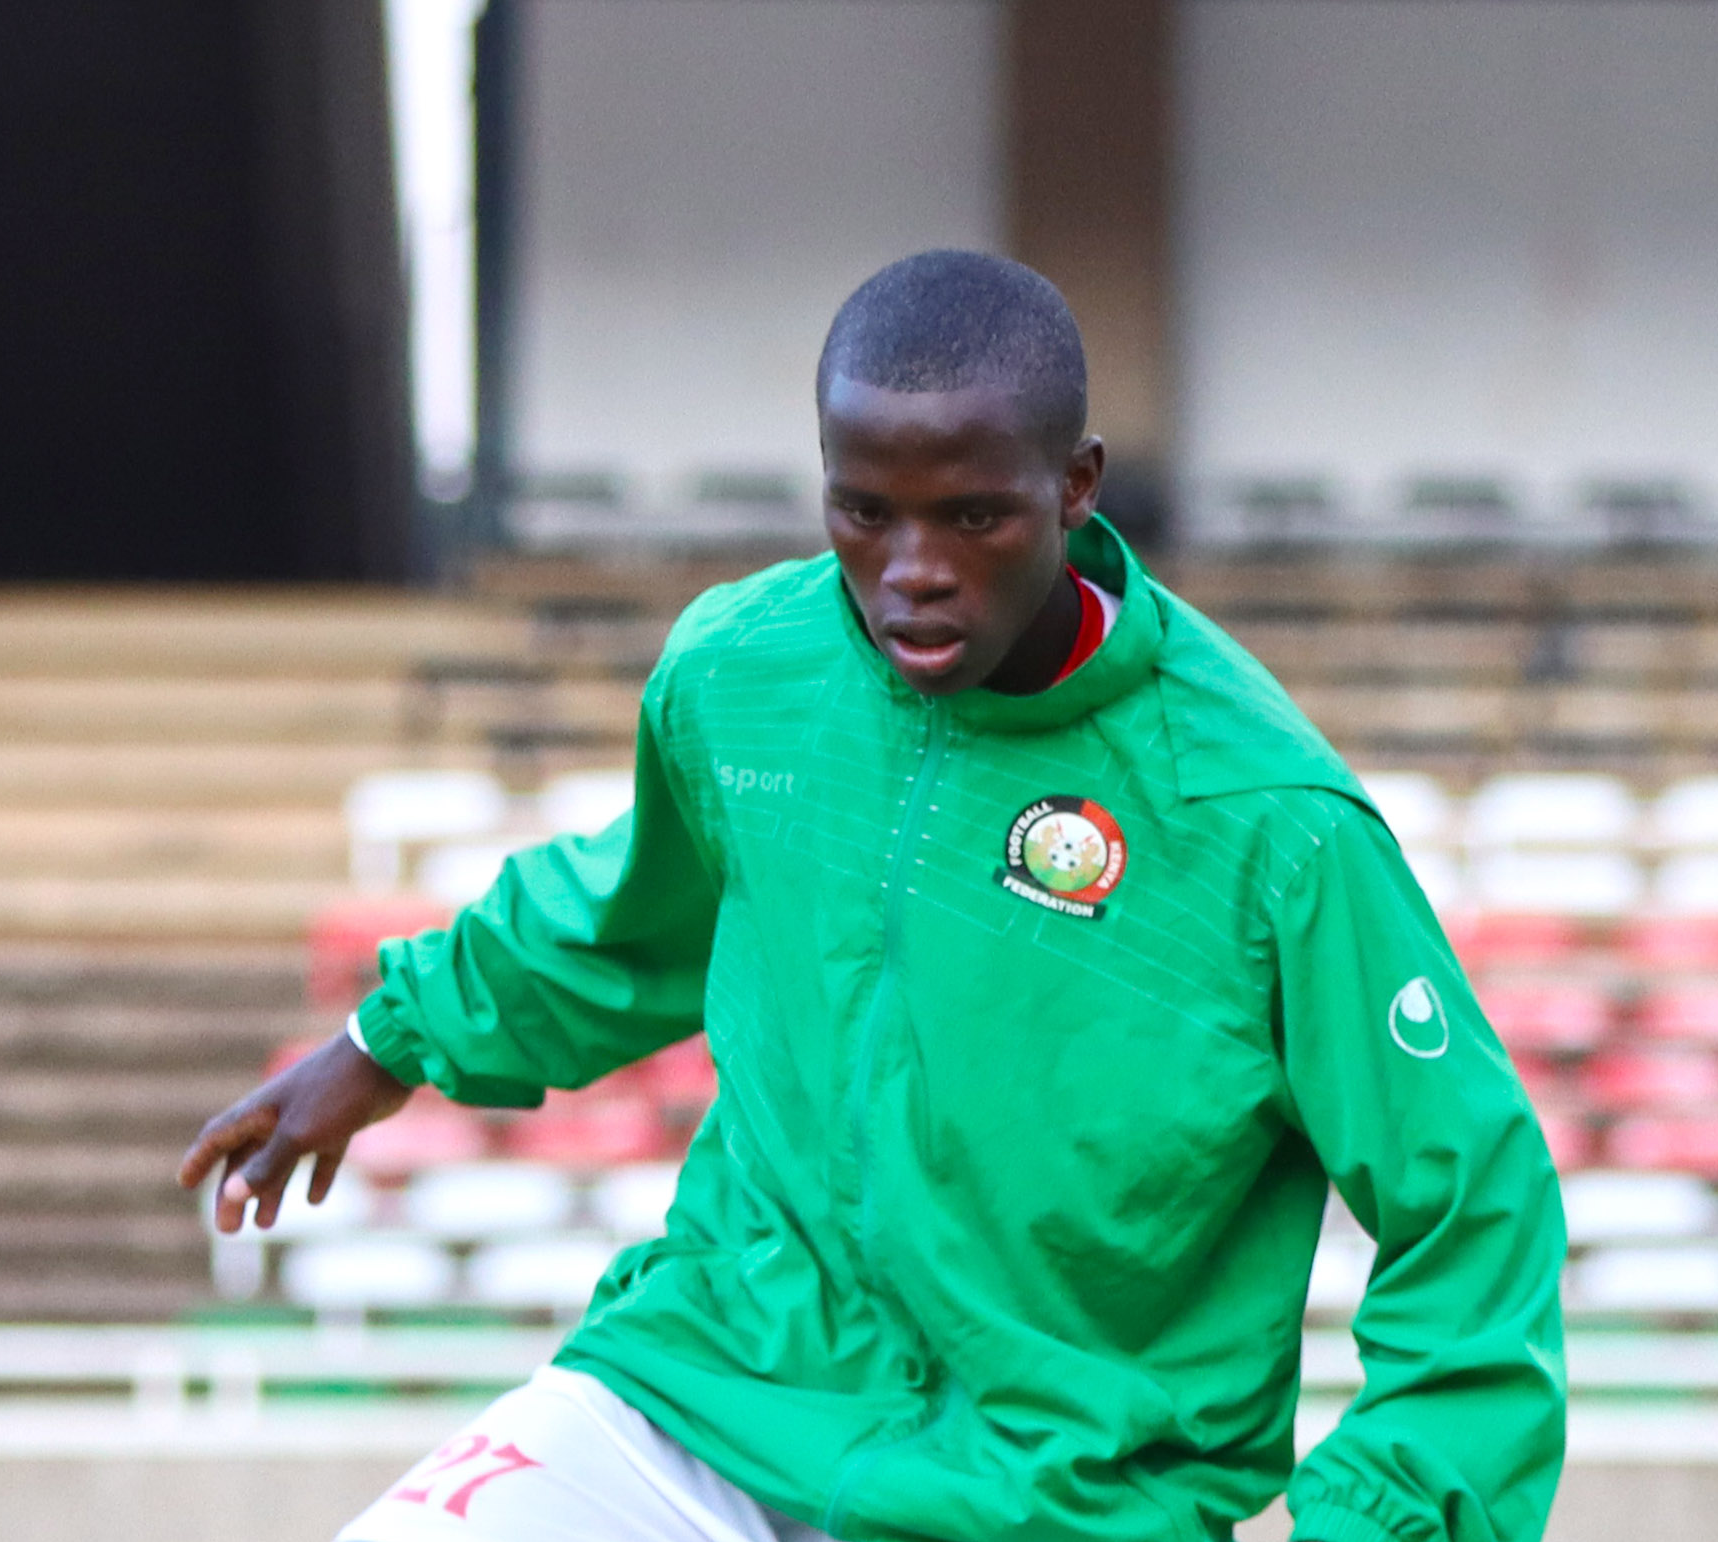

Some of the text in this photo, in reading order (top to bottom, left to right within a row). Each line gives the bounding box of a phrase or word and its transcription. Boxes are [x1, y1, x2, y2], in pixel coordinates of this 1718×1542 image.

[1007, 800, 1054, 867] FOOTBALL
[1096, 841, 1123, 889] KENYA
[1002, 875, 1095, 918] FEDERATION
[387, 1434, 546, 1521] 27
